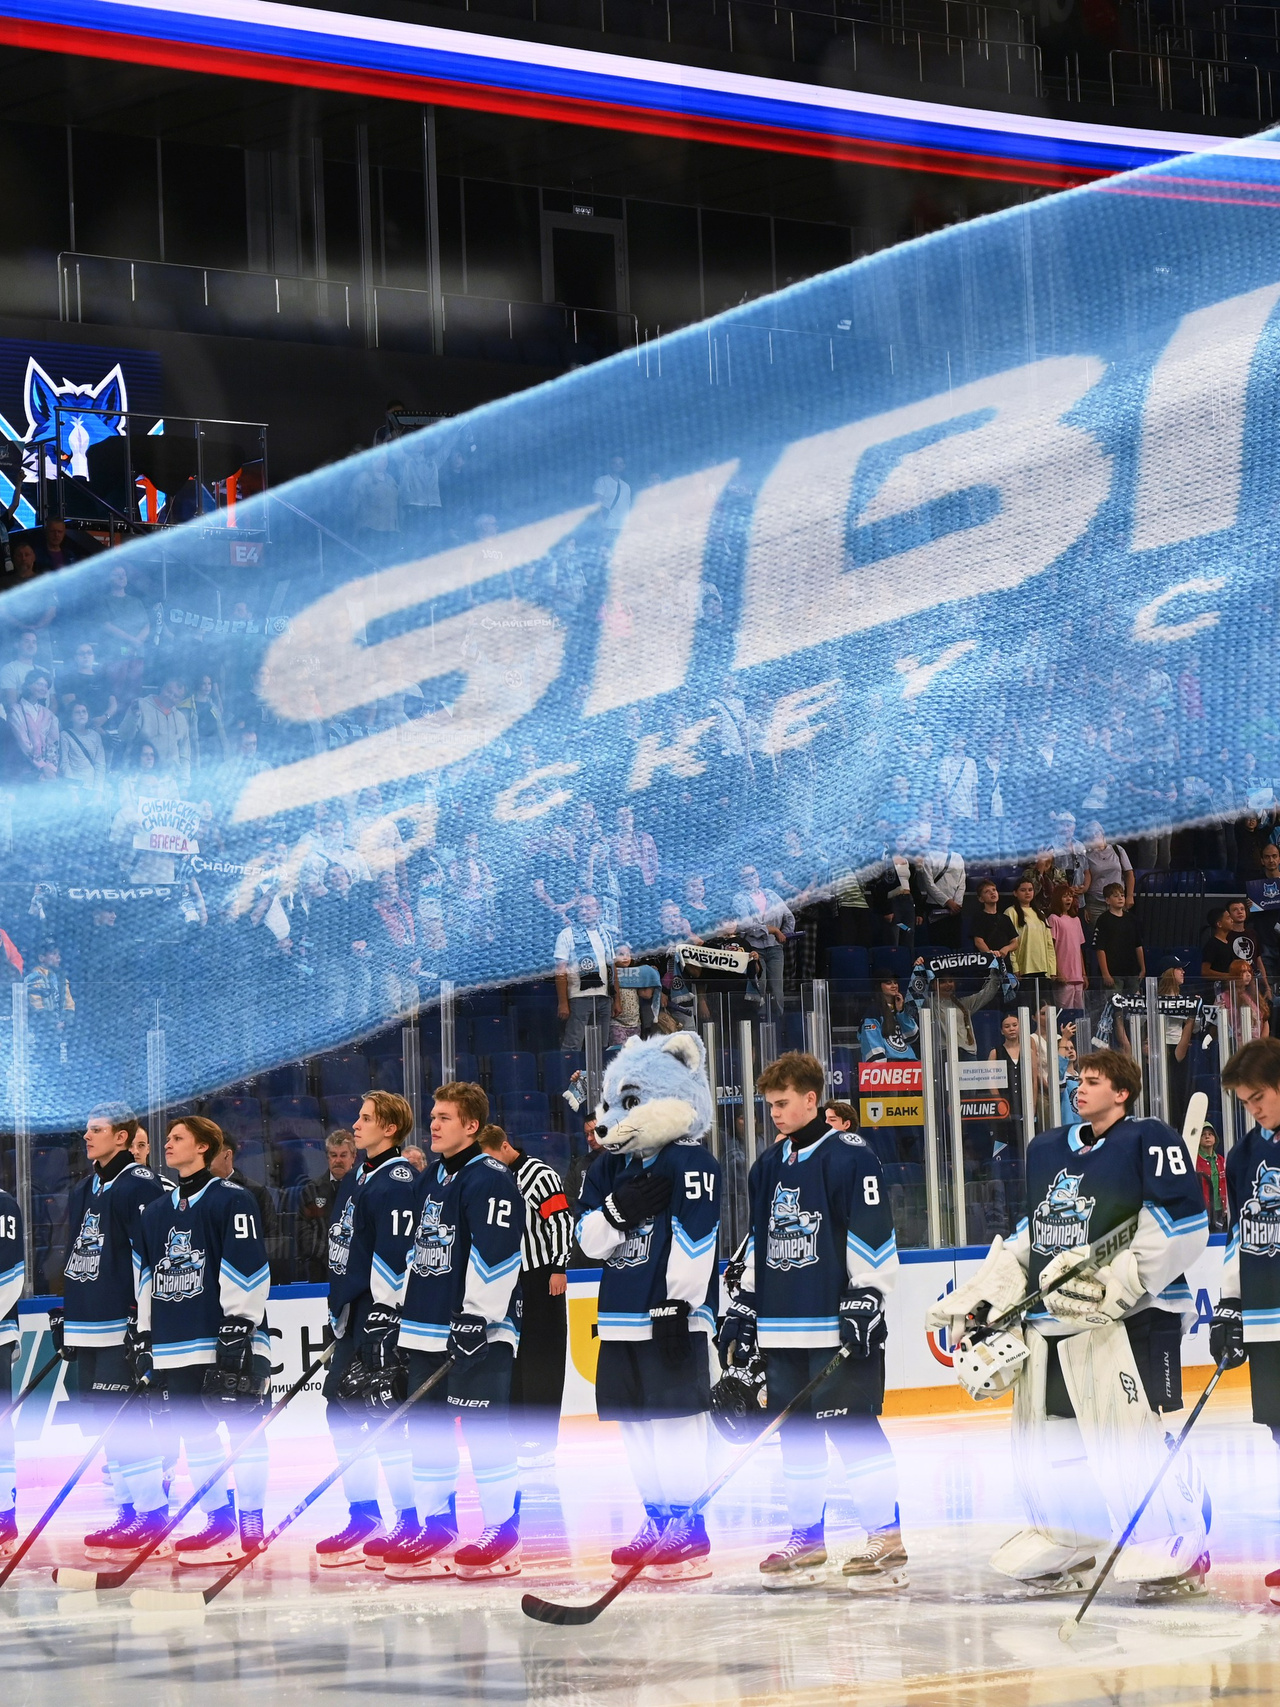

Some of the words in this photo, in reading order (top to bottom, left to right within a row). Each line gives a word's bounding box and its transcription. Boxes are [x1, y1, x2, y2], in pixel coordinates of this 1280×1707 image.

[235, 545, 259, 563] E4
[681, 948, 740, 968] СИБИРЬ
[929, 954, 988, 972] СИБИРЬ
[860, 1067, 922, 1086] FONBET
[885, 1106, 919, 1118] БАНК
[1148, 1145, 1187, 1177] 78
[683, 1170, 715, 1202] 54
[862, 1175, 881, 1206] 8
[390, 1208, 414, 1237] 17
[486, 1197, 512, 1229] 12
[233, 1213, 258, 1240] 91
[446, 1395, 490, 1409] BAUER
[816, 1407, 848, 1420] CCM
